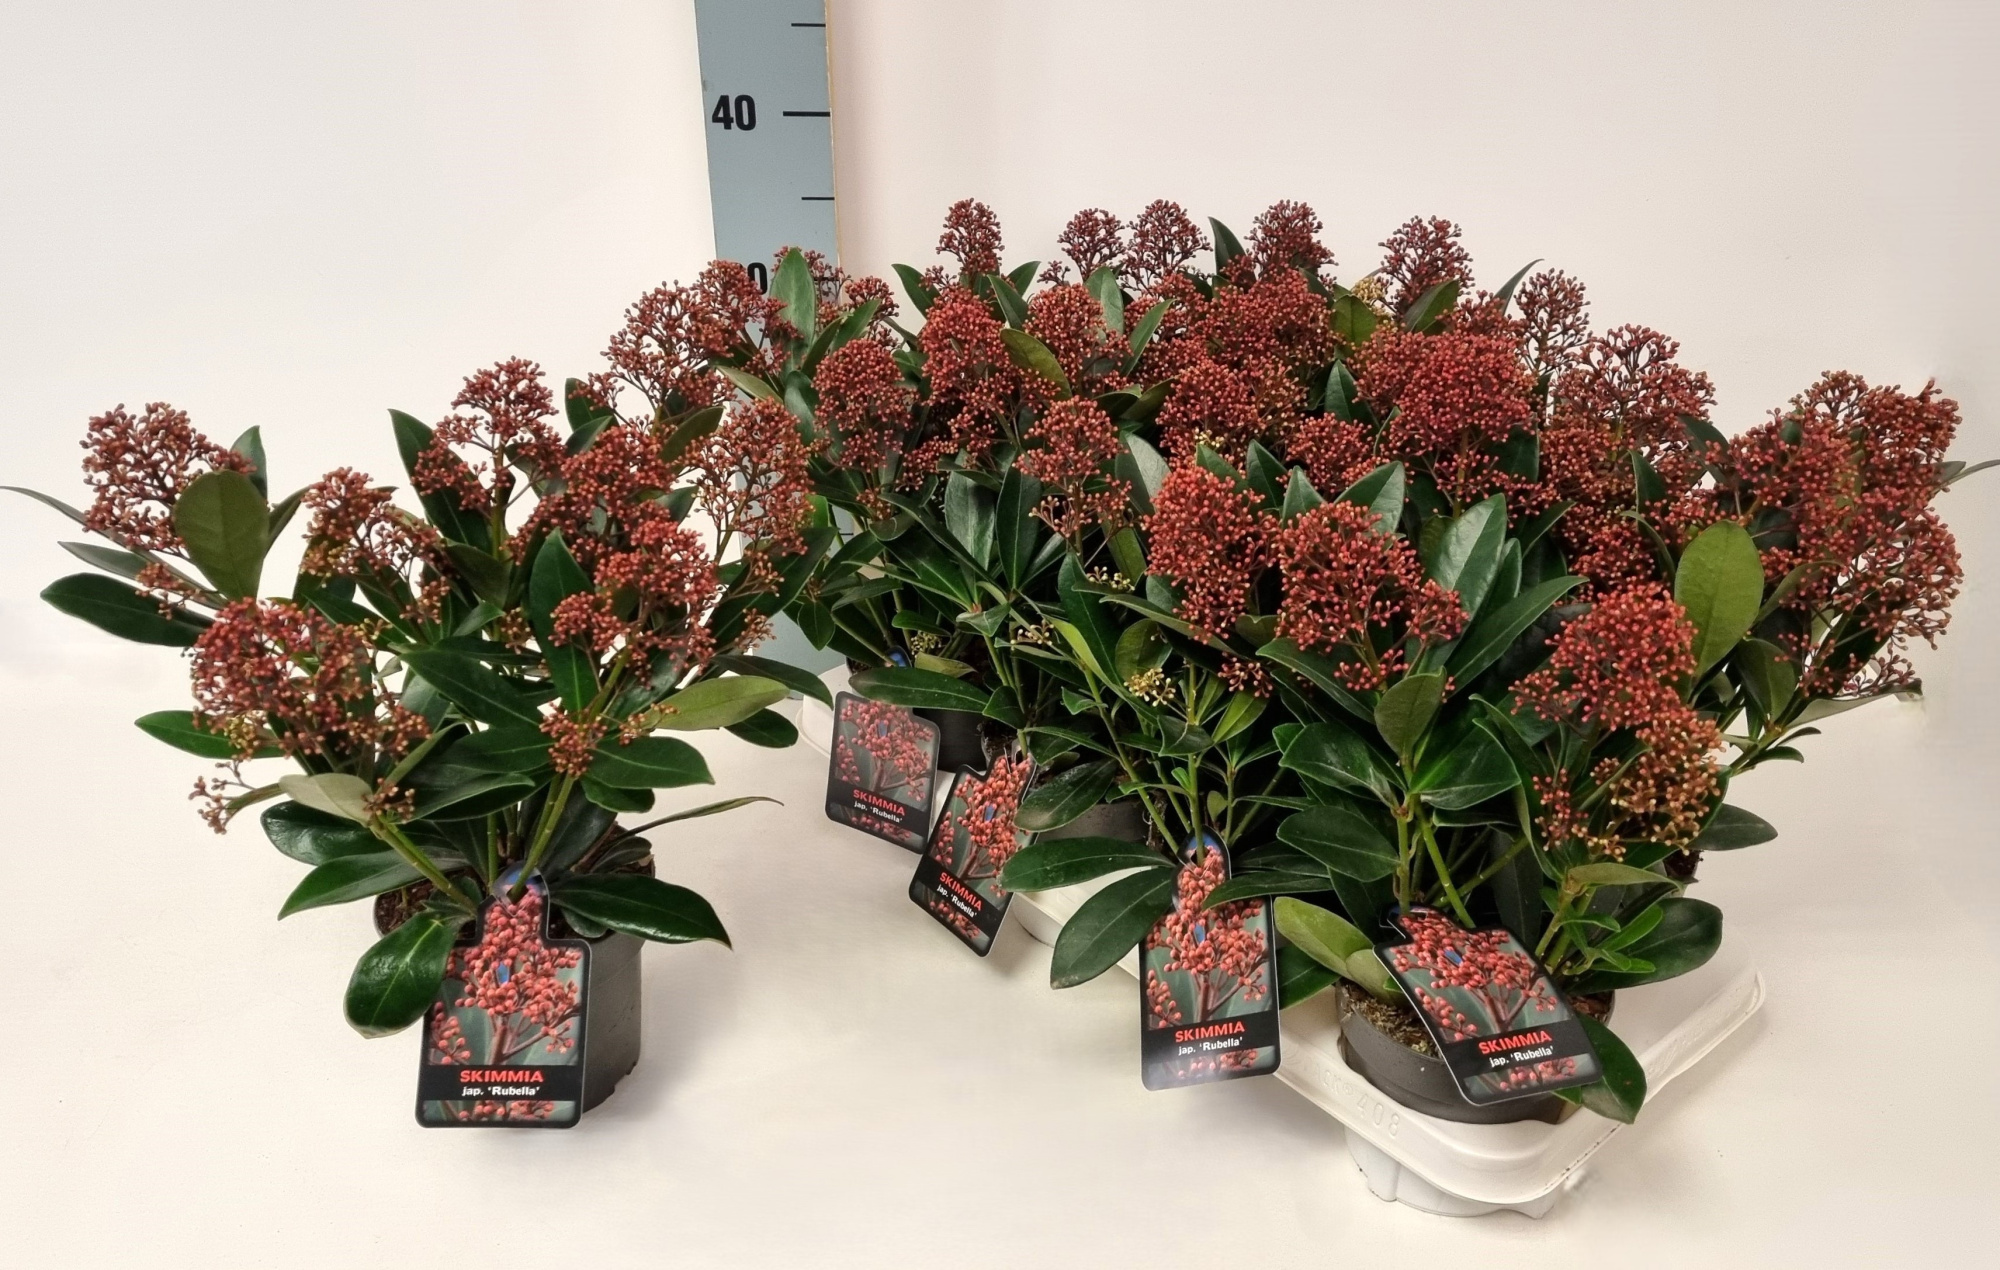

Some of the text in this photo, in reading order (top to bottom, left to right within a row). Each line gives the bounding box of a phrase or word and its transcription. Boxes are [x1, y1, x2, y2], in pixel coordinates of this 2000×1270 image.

[711, 94, 757, 131] 40
[853, 789, 905, 816] SKIMMIA
[854, 801, 868, 811] jap.
[937, 884, 949, 897] jap.
[939, 872, 983, 911] SKIMMIA
[1175, 1021, 1246, 1042] SKIMMIA
[1478, 1030, 1553, 1055] SKIMMIA
[1178, 1046, 1196, 1055] jap.
[1489, 1057, 1509, 1067] jap.
[460, 1070, 544, 1083] SKIMMIA
[462, 1086, 484, 1096] jap.
